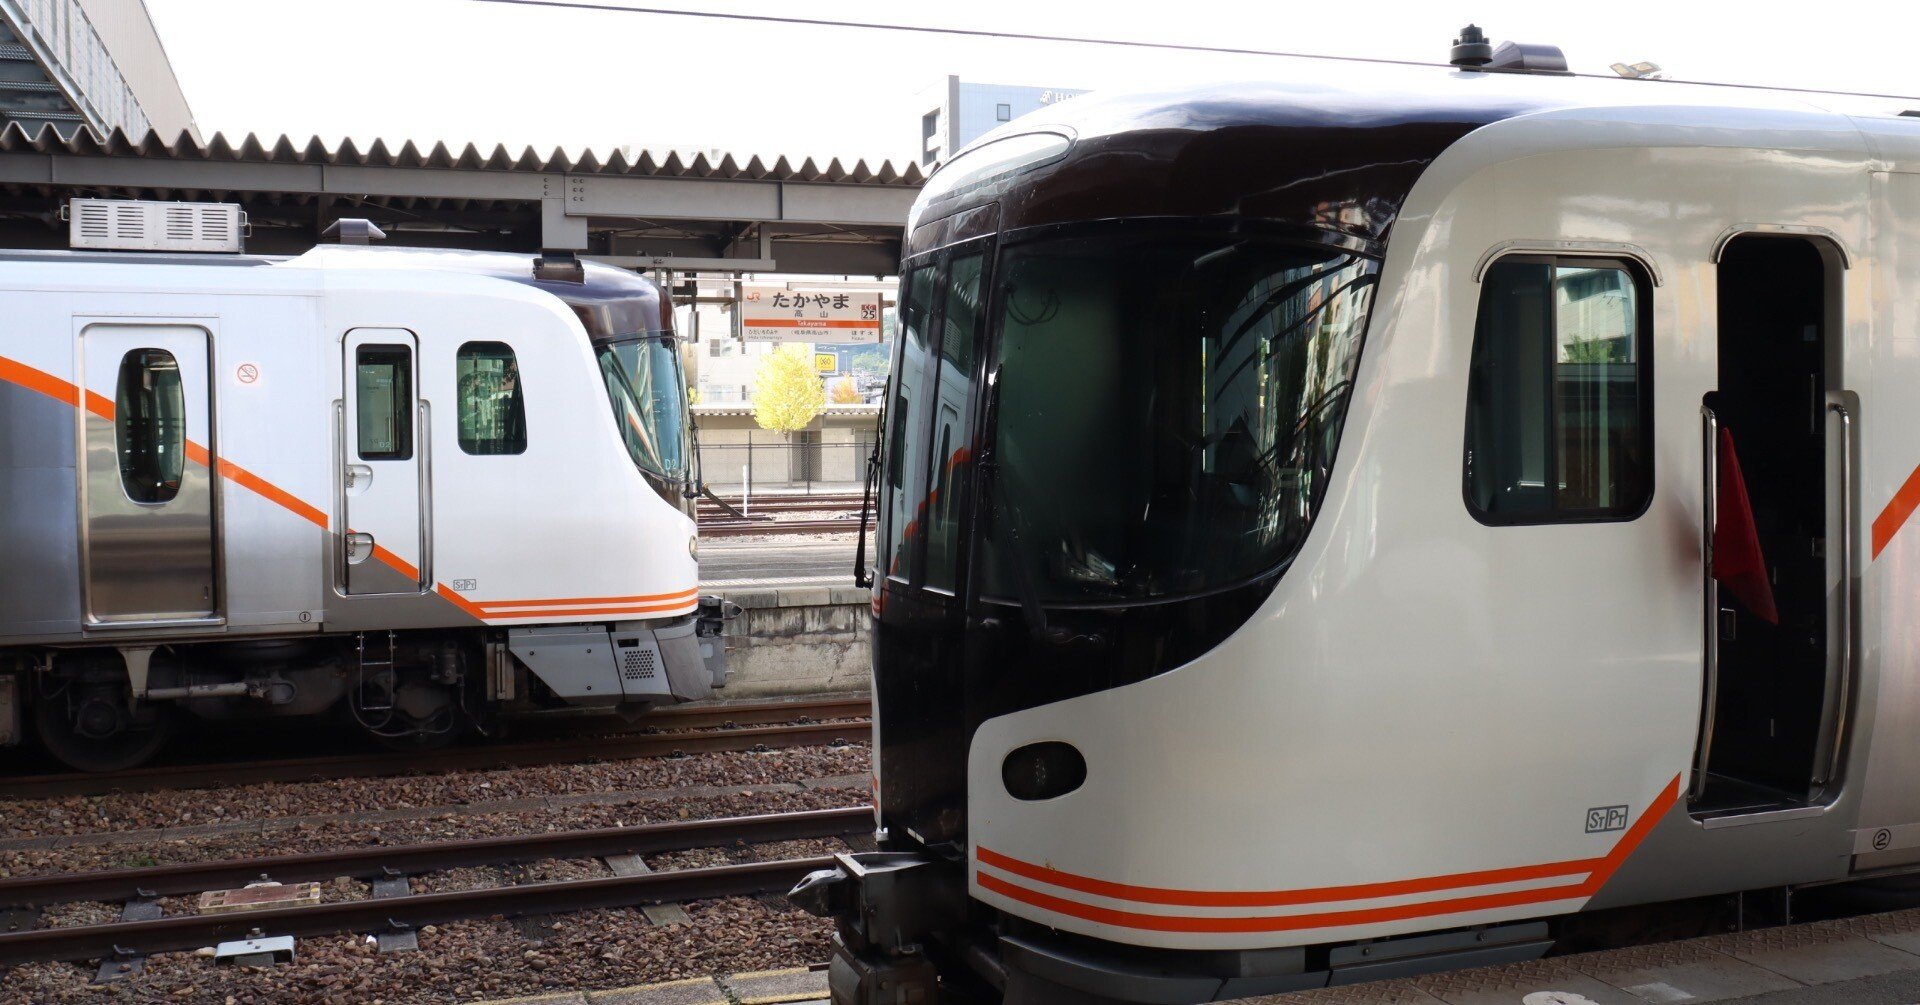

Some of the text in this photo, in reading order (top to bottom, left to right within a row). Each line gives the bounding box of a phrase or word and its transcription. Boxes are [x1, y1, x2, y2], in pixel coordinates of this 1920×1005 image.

[747, 292, 760, 301] JR
[772, 292, 850, 309] たかやま
[794, 309, 829, 319] 高山
[862, 310, 875, 319] 25
[797, 320, 827, 328] Takayama
[664, 458, 677, 470] D2
